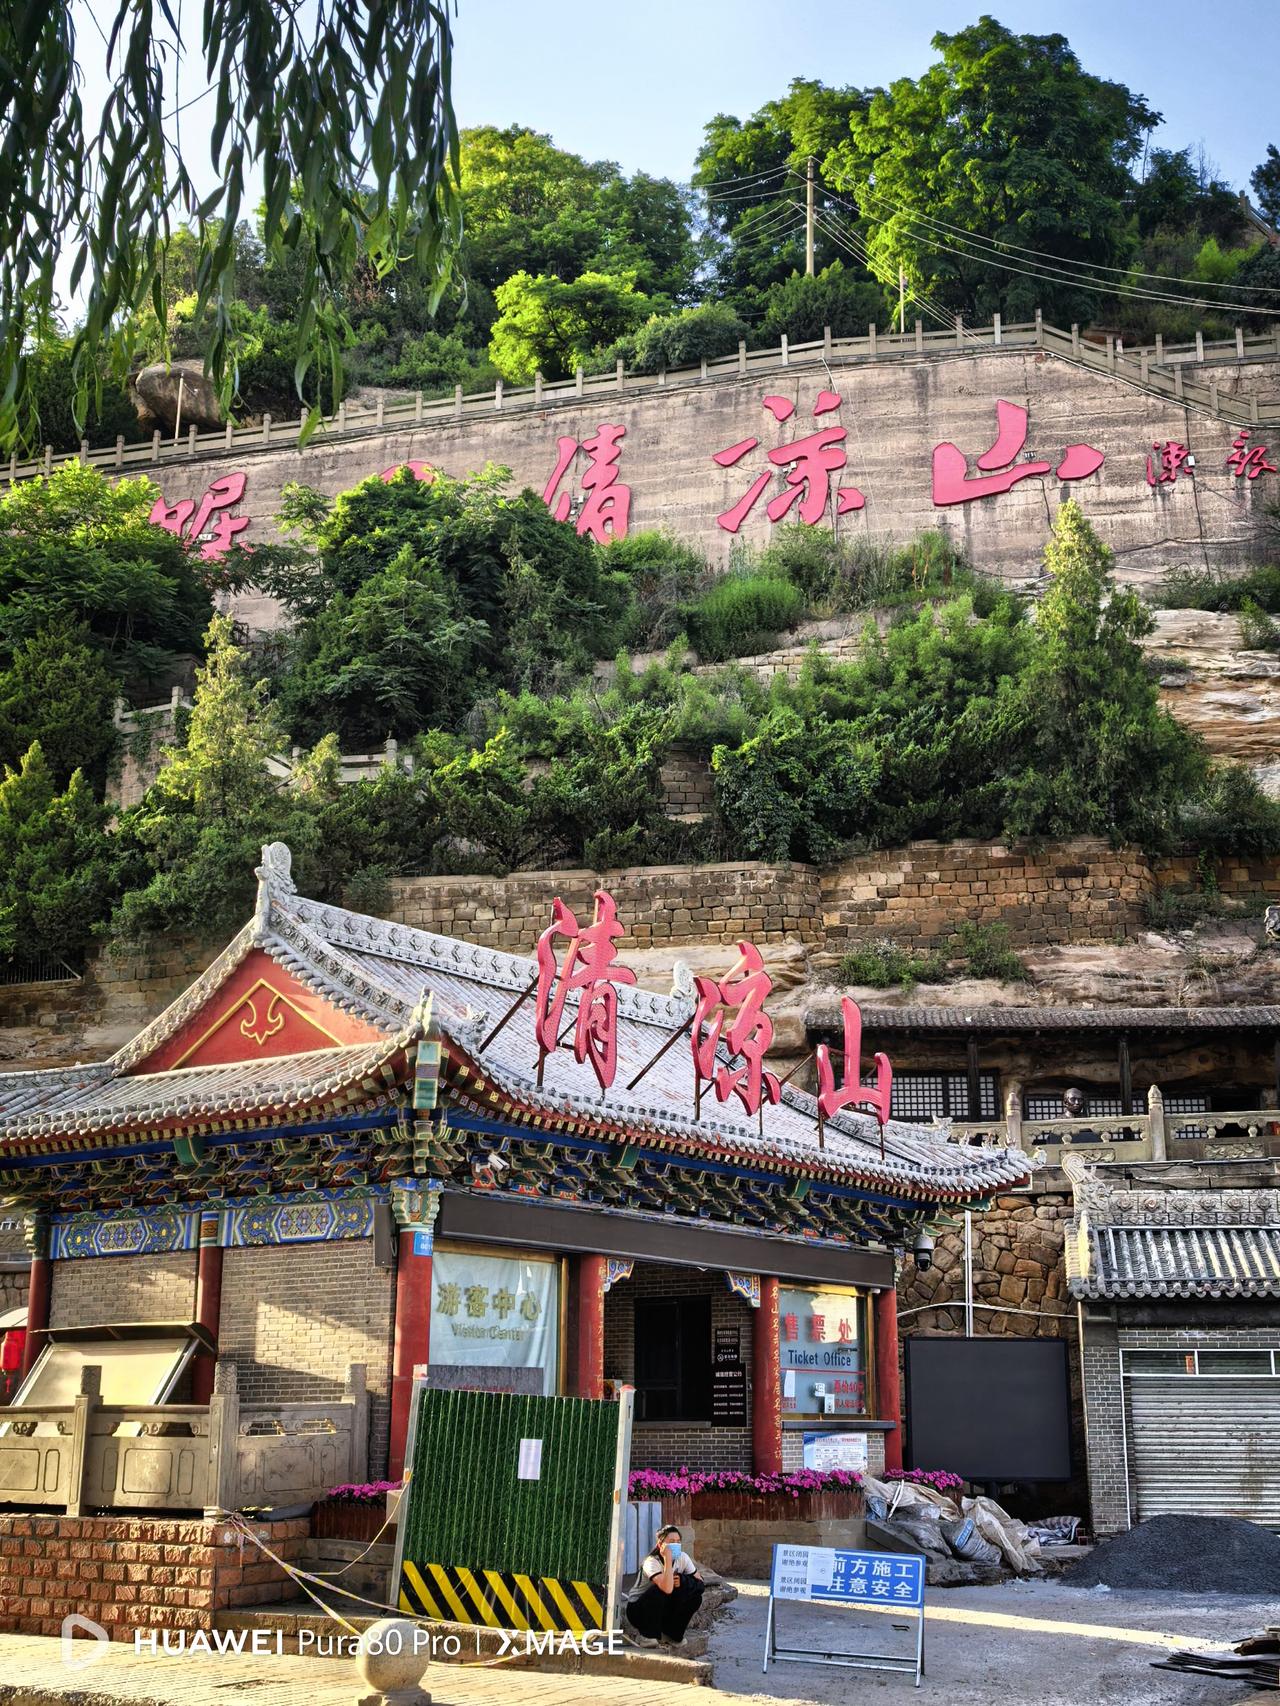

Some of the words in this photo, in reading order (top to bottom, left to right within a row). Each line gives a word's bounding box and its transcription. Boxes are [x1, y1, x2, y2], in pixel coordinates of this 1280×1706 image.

[436, 1282, 542, 1321] 游客中心
[451, 1322, 488, 1338] Visitor
[785, 1312, 853, 1344] 售票处
[788, 1349, 819, 1365] Ticket
[823, 1351, 852, 1367] Office
[832, 1556, 914, 1578] 前方施工
[826, 1576, 913, 1599] 注意安全
